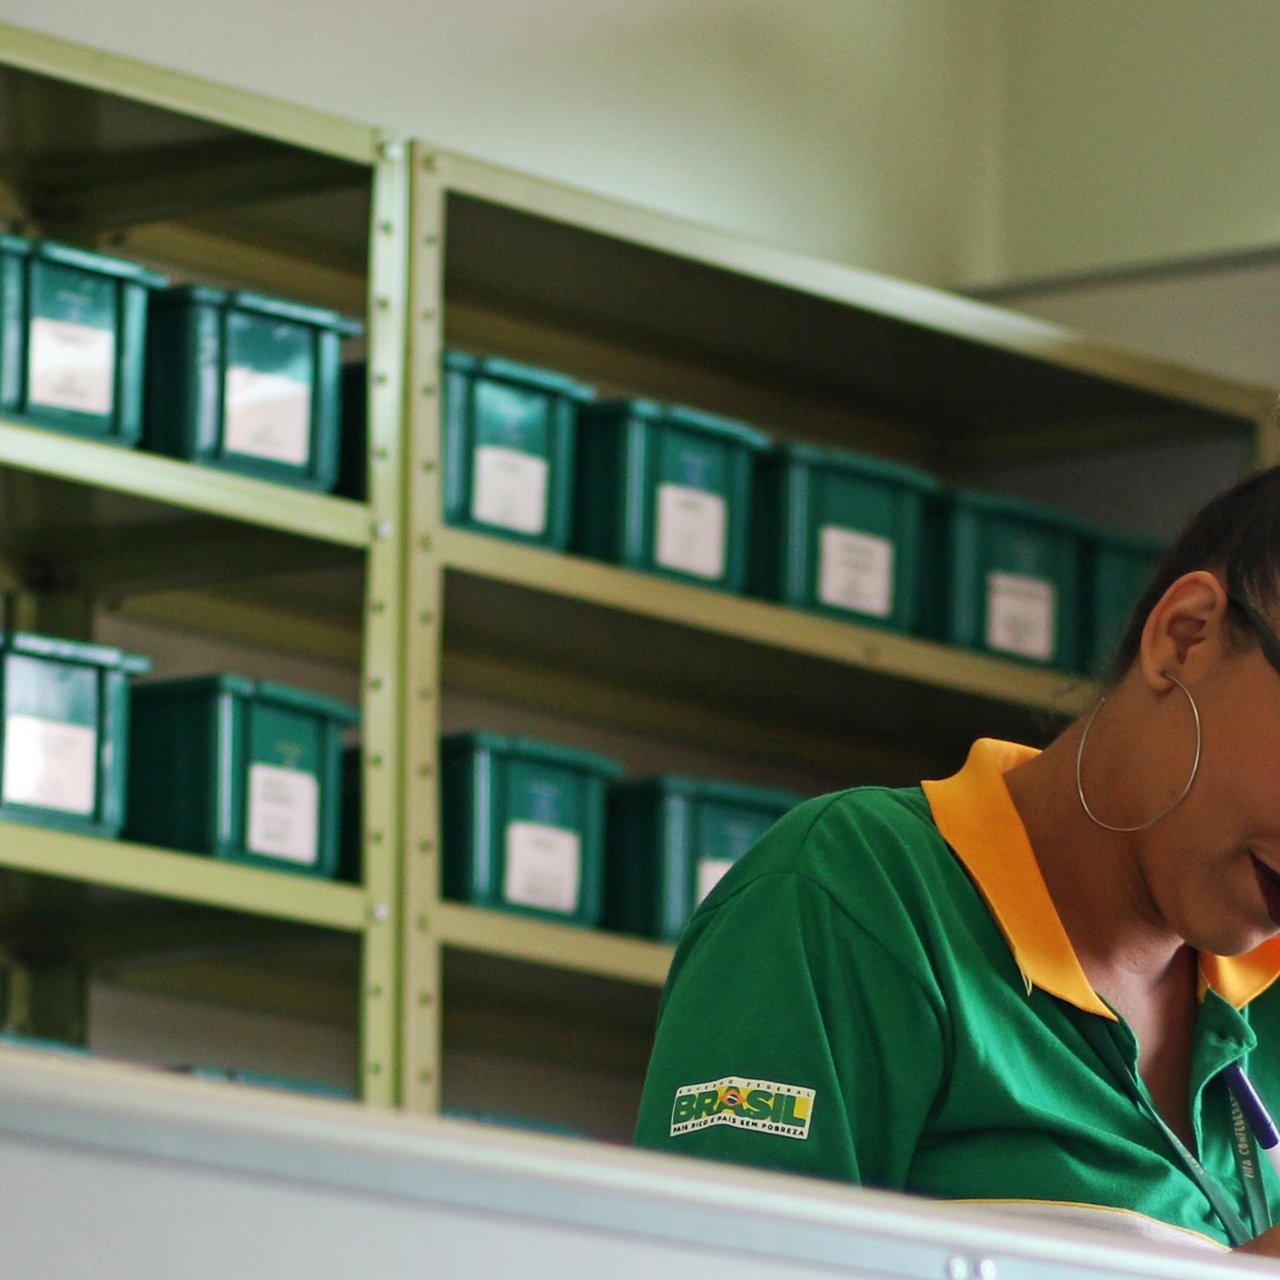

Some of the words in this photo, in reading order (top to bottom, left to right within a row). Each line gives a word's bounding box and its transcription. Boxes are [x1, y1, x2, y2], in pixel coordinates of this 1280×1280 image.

[673, 1086, 806, 1128] BRASIL
[691, 1119, 709, 1129] RICO
[740, 1119, 758, 1128] SEM
[762, 1123, 804, 1137] POBREZA
